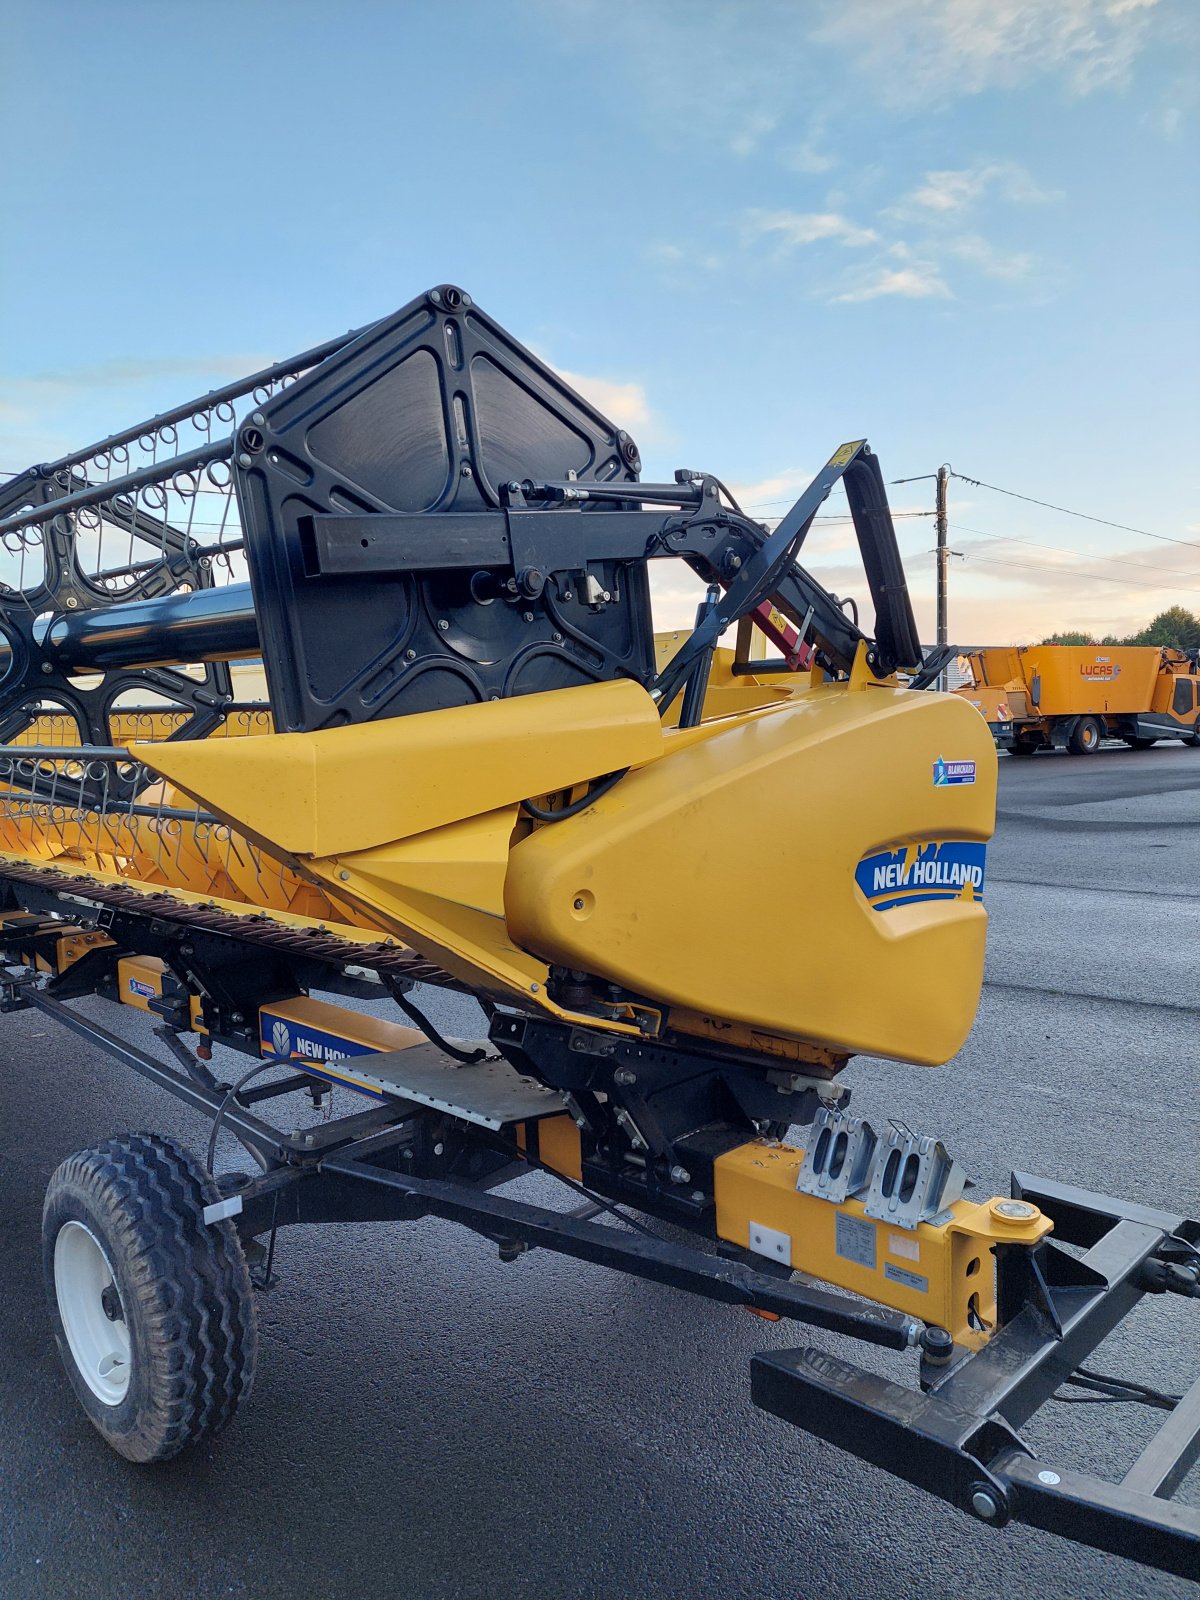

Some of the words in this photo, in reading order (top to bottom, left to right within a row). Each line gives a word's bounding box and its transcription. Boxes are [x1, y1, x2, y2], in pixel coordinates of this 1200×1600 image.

[1080, 664, 1112, 675] LUCAS
[874, 863, 911, 891] NEW
[913, 861, 983, 888] HOLLAND
[296, 1036, 322, 1059] NEW
